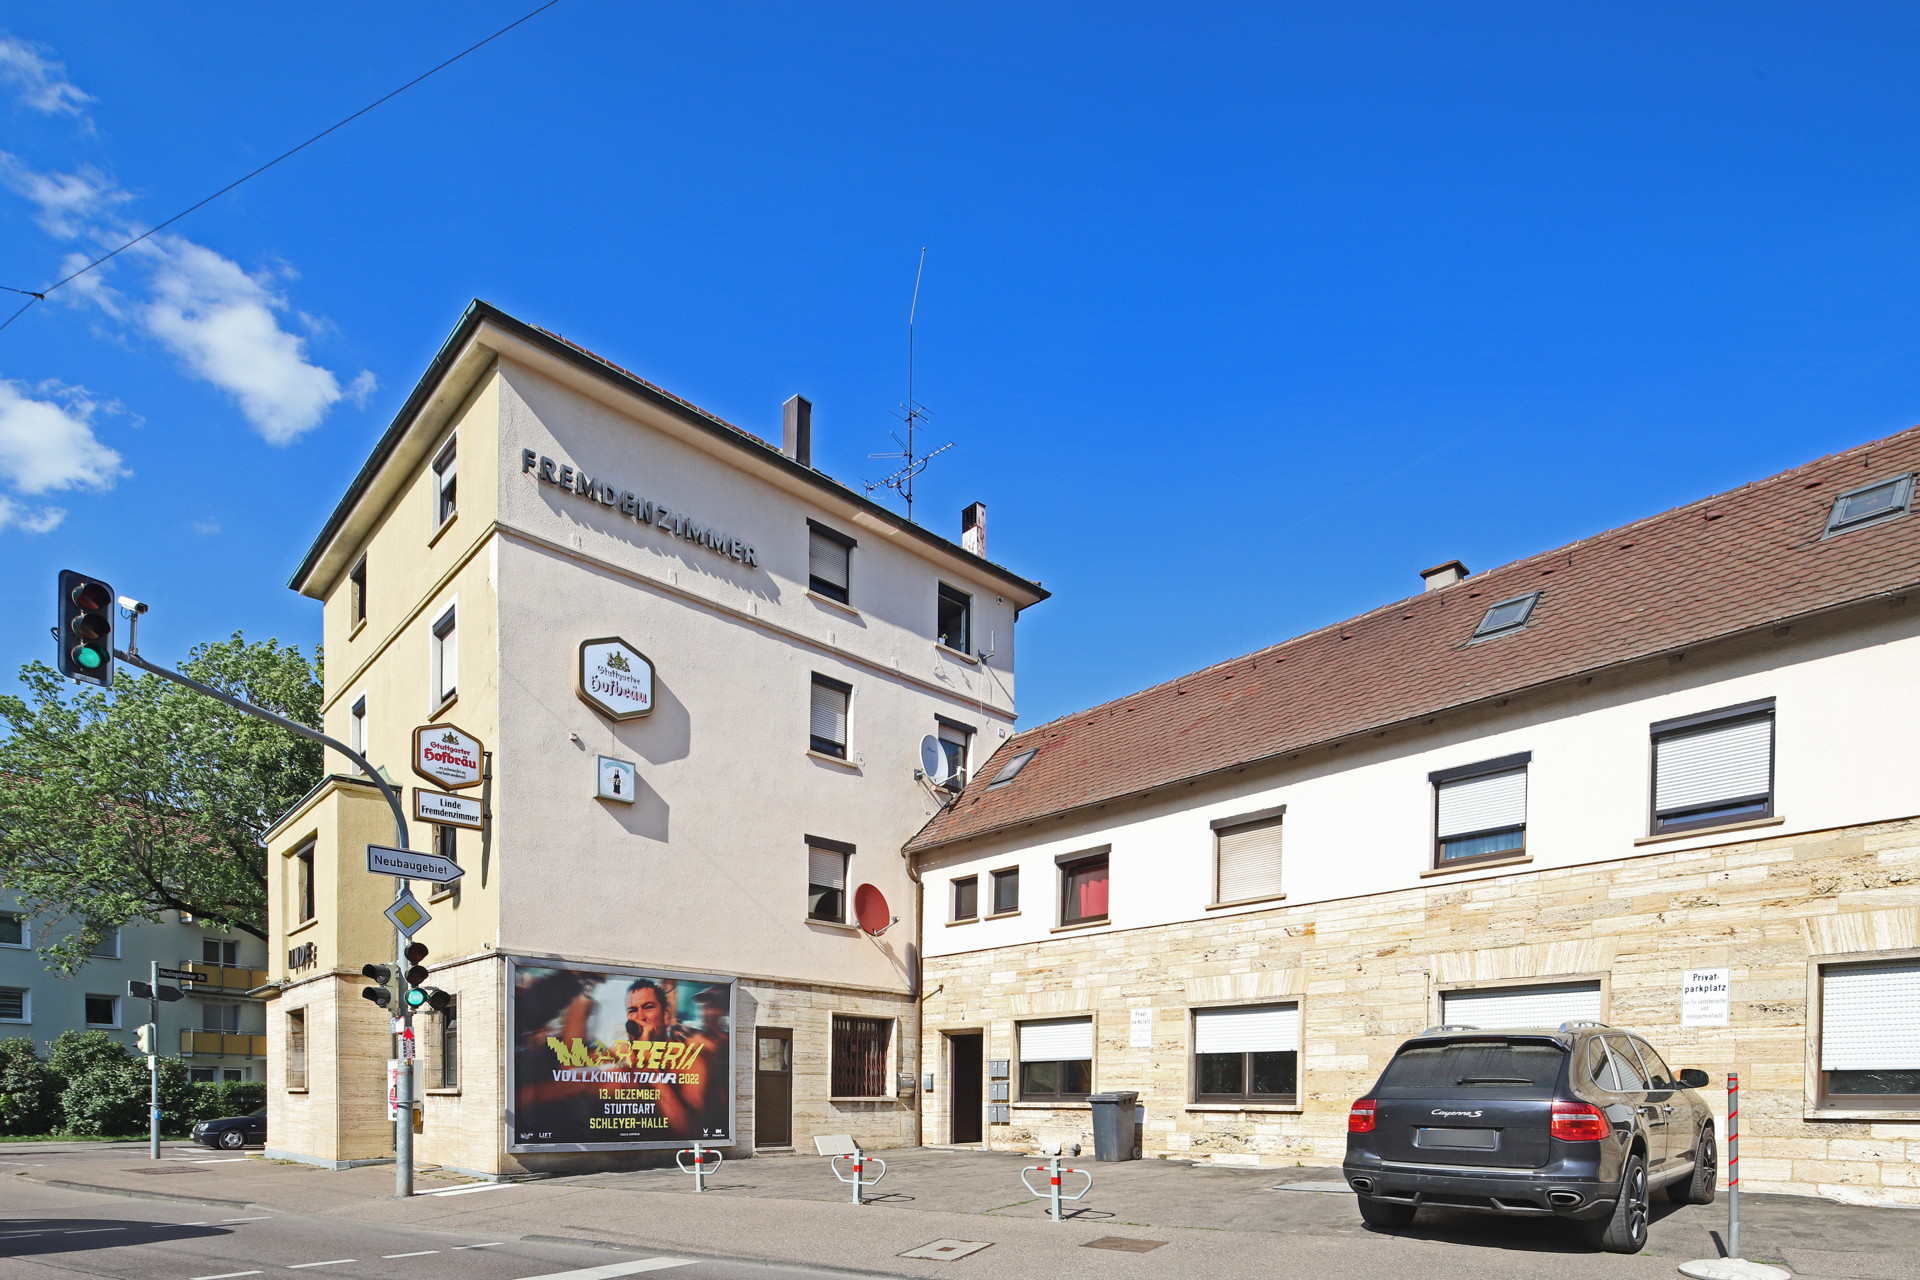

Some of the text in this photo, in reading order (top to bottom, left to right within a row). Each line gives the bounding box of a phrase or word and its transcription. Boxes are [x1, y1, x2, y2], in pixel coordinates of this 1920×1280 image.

[522, 448, 758, 568] FREMDENZIMMER
[597, 665, 640, 686] Stuttgarter
[591, 675, 647, 704] Hofbräu
[430, 741, 471, 756] Stuttgarter
[424, 748, 477, 769] Hofbräu
[440, 798, 462, 810] Linde
[421, 805, 479, 822] Fremdenzimmer
[374, 855, 448, 875] Neubaugebiet
[1693, 973, 1719, 982] Privat-
[1684, 984, 1726, 994] parkplatz
[552, 1070, 700, 1085] VOLLKONTAKT TOUR 2022
[599, 1088, 661, 1100] 13. DEZEMBER
[604, 1103, 656, 1115] STUTTGART
[1431, 1108, 1483, 1118] Cayenne S
[589, 1117, 669, 1129] SCHLEYER-HALLE
